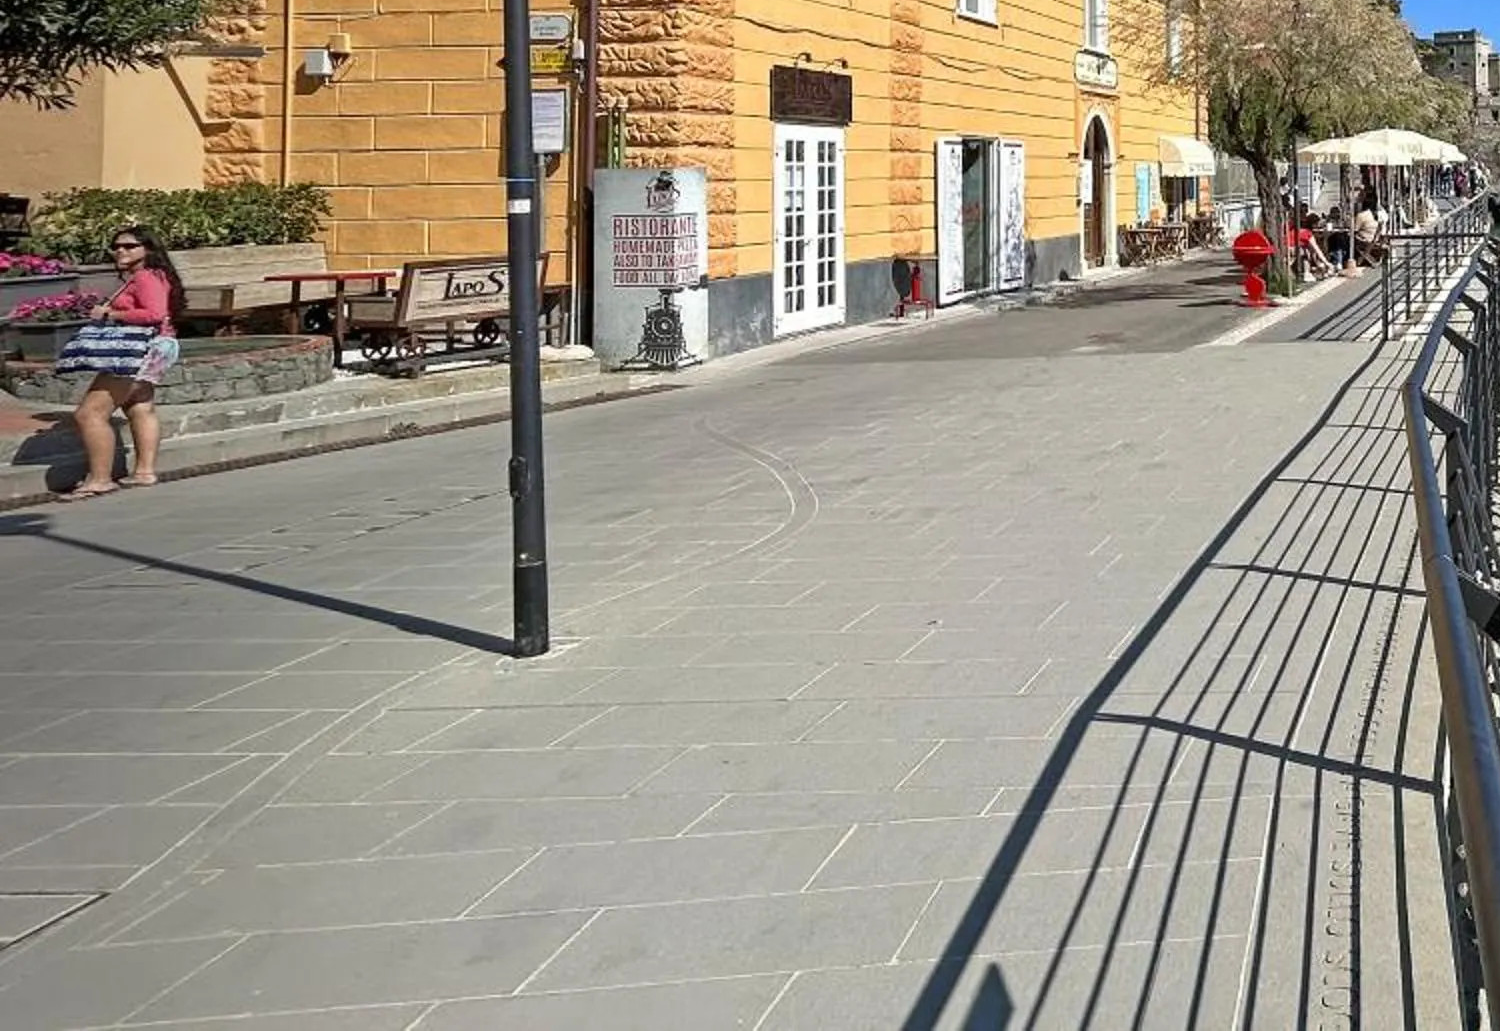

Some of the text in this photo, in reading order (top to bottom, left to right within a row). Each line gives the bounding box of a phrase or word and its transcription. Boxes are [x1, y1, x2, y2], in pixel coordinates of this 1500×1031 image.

[613, 216, 697, 236] RISTORANTE
[613, 240, 675, 253] HOMEMADE
[613, 255, 638, 267] ALSO
[641, 255, 652, 267] TO
[613, 272, 638, 283] FOOD
